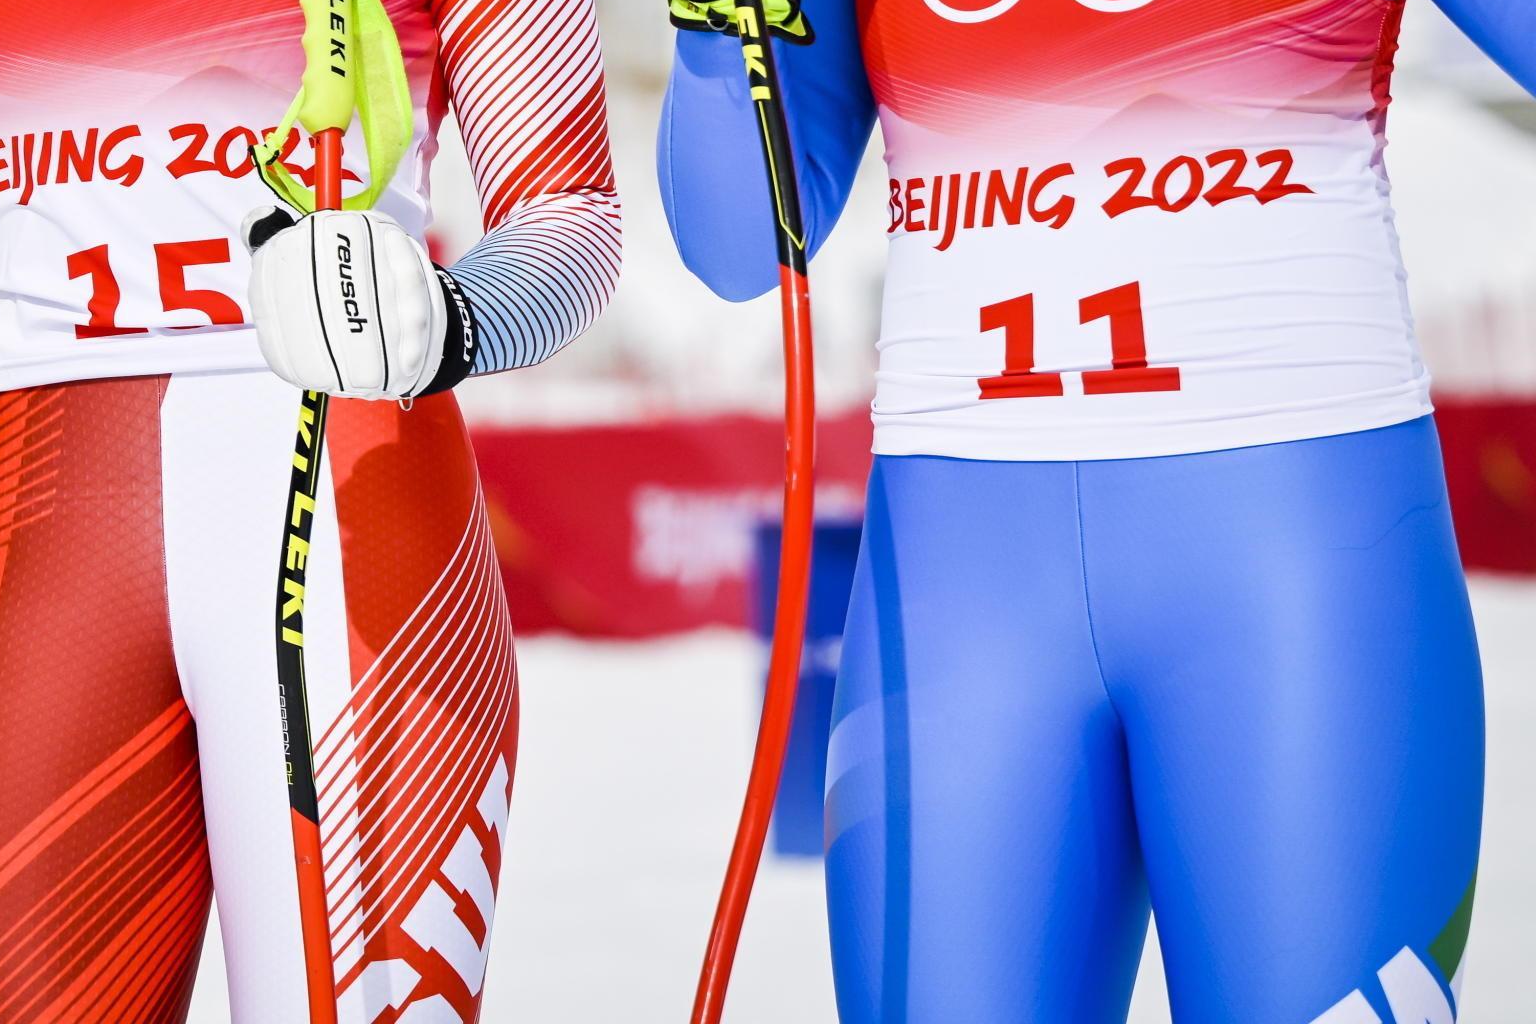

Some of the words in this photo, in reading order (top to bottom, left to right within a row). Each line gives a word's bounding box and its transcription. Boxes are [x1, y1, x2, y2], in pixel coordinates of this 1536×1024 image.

[887, 162, 1075, 252] BEIJING
[1101, 149, 1316, 219] 2022
[66, 238, 246, 340] 15
[336, 232, 368, 334] reusch
[977, 280, 1181, 400] 11
[282, 489, 316, 648] LEKI
